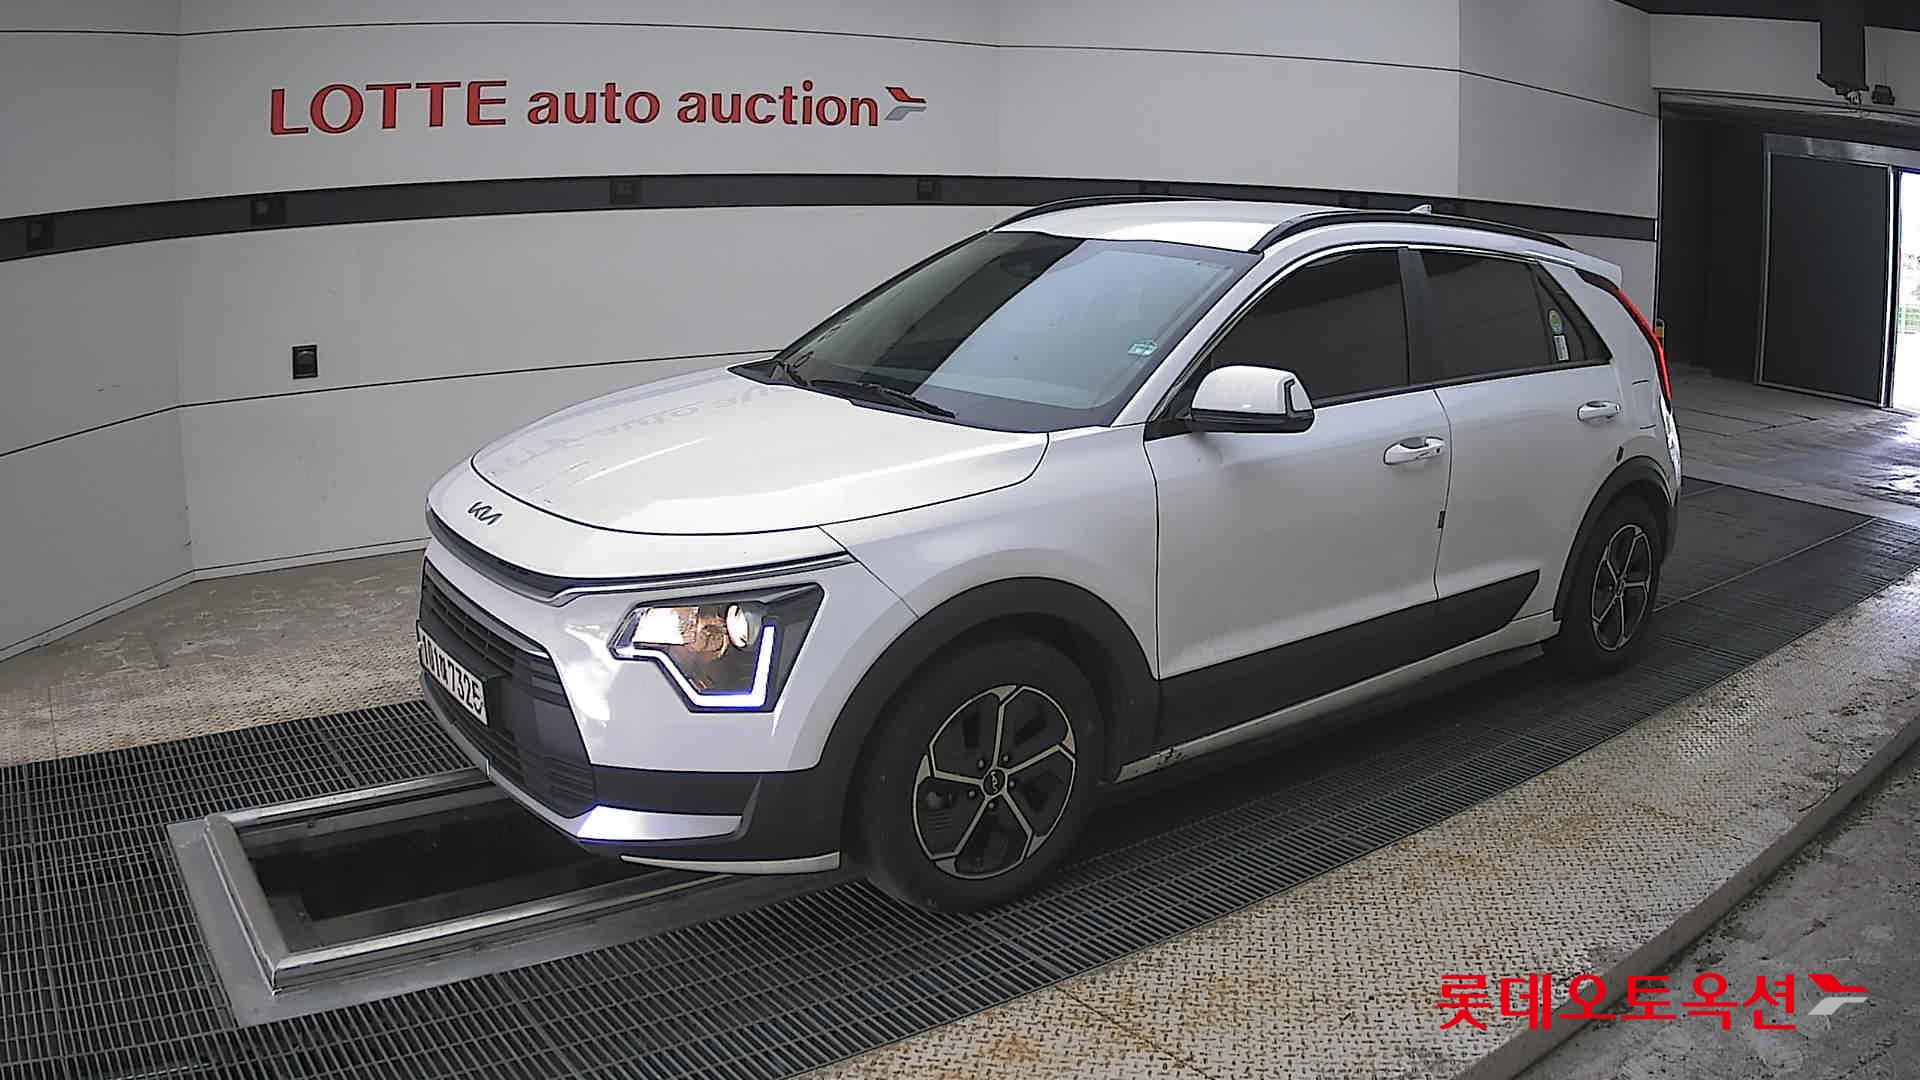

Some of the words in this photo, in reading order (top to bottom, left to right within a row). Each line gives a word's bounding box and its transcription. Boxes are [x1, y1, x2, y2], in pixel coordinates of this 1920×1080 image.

[270, 80, 507, 136] LOTTE
[527, 82, 661, 125] auto
[676, 80, 879, 127] auction
